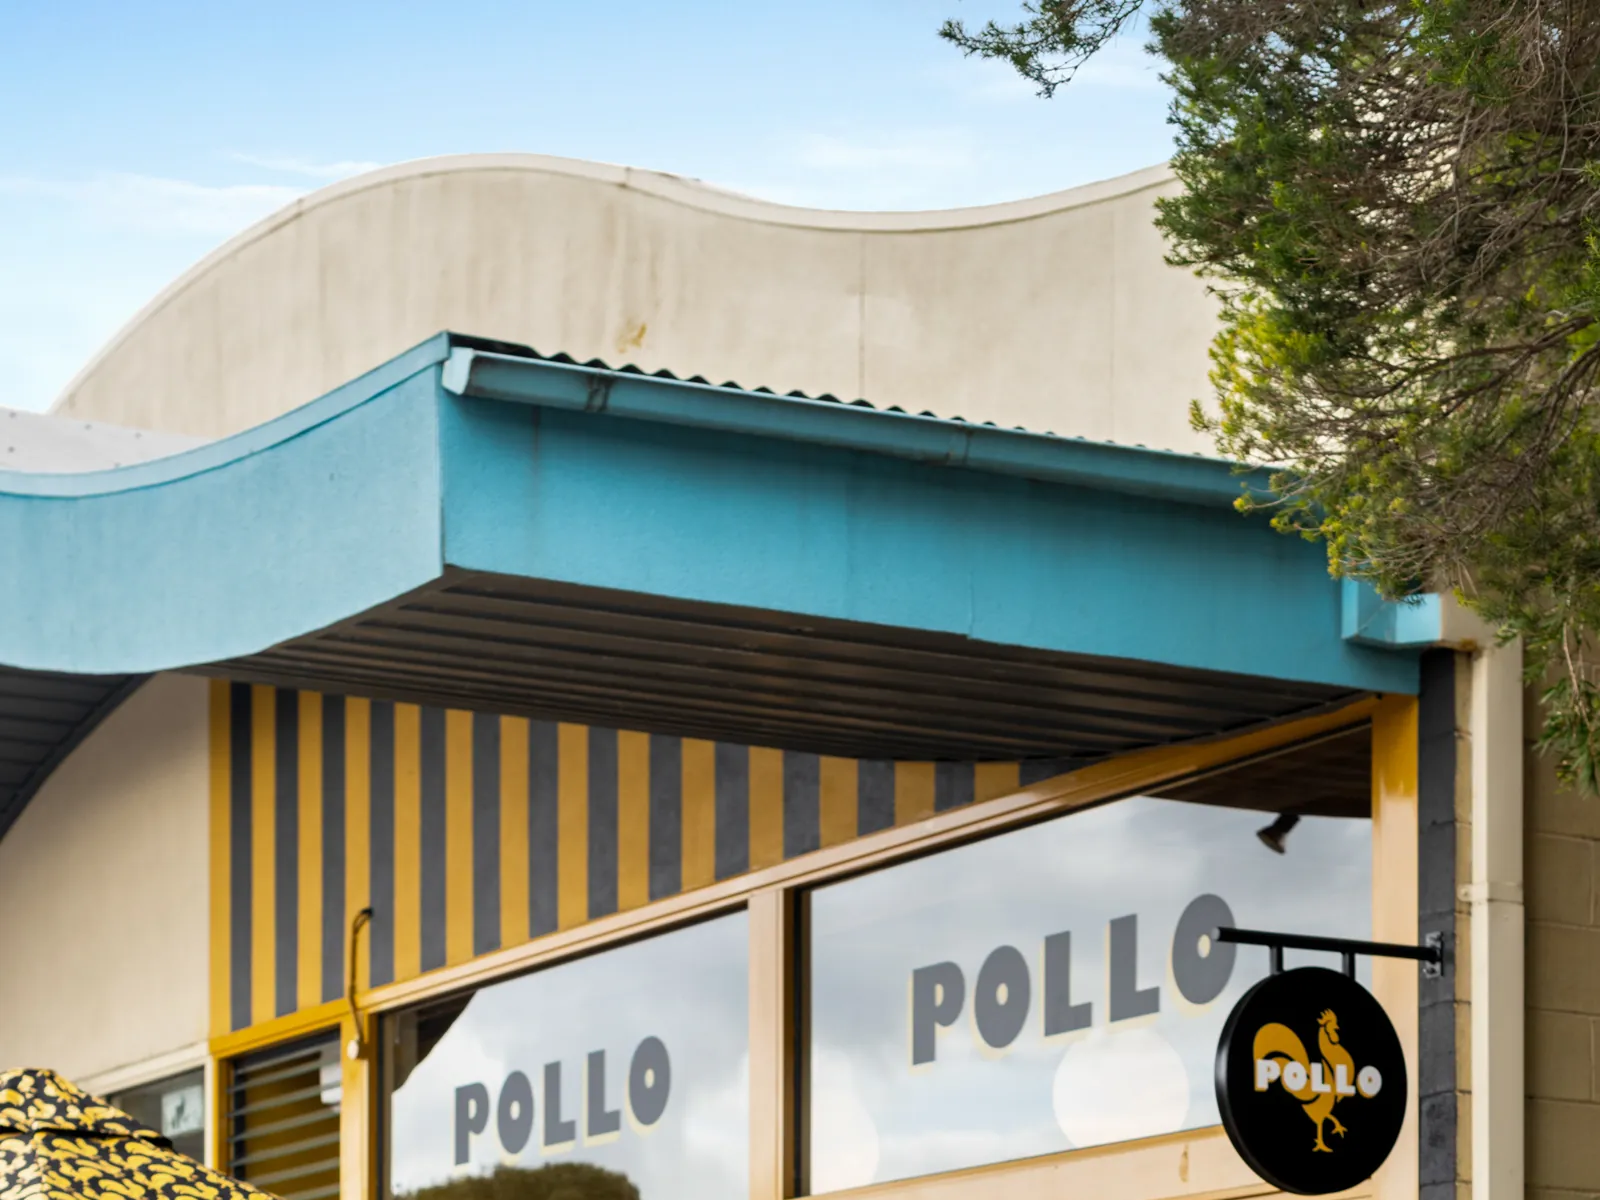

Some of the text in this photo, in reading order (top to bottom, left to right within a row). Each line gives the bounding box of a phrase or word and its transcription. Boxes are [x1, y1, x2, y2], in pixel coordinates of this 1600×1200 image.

[911, 894, 1237, 1066] POLLO
[454, 1036, 671, 1166] POLLO
[1254, 1058, 1383, 1099] POLLO
